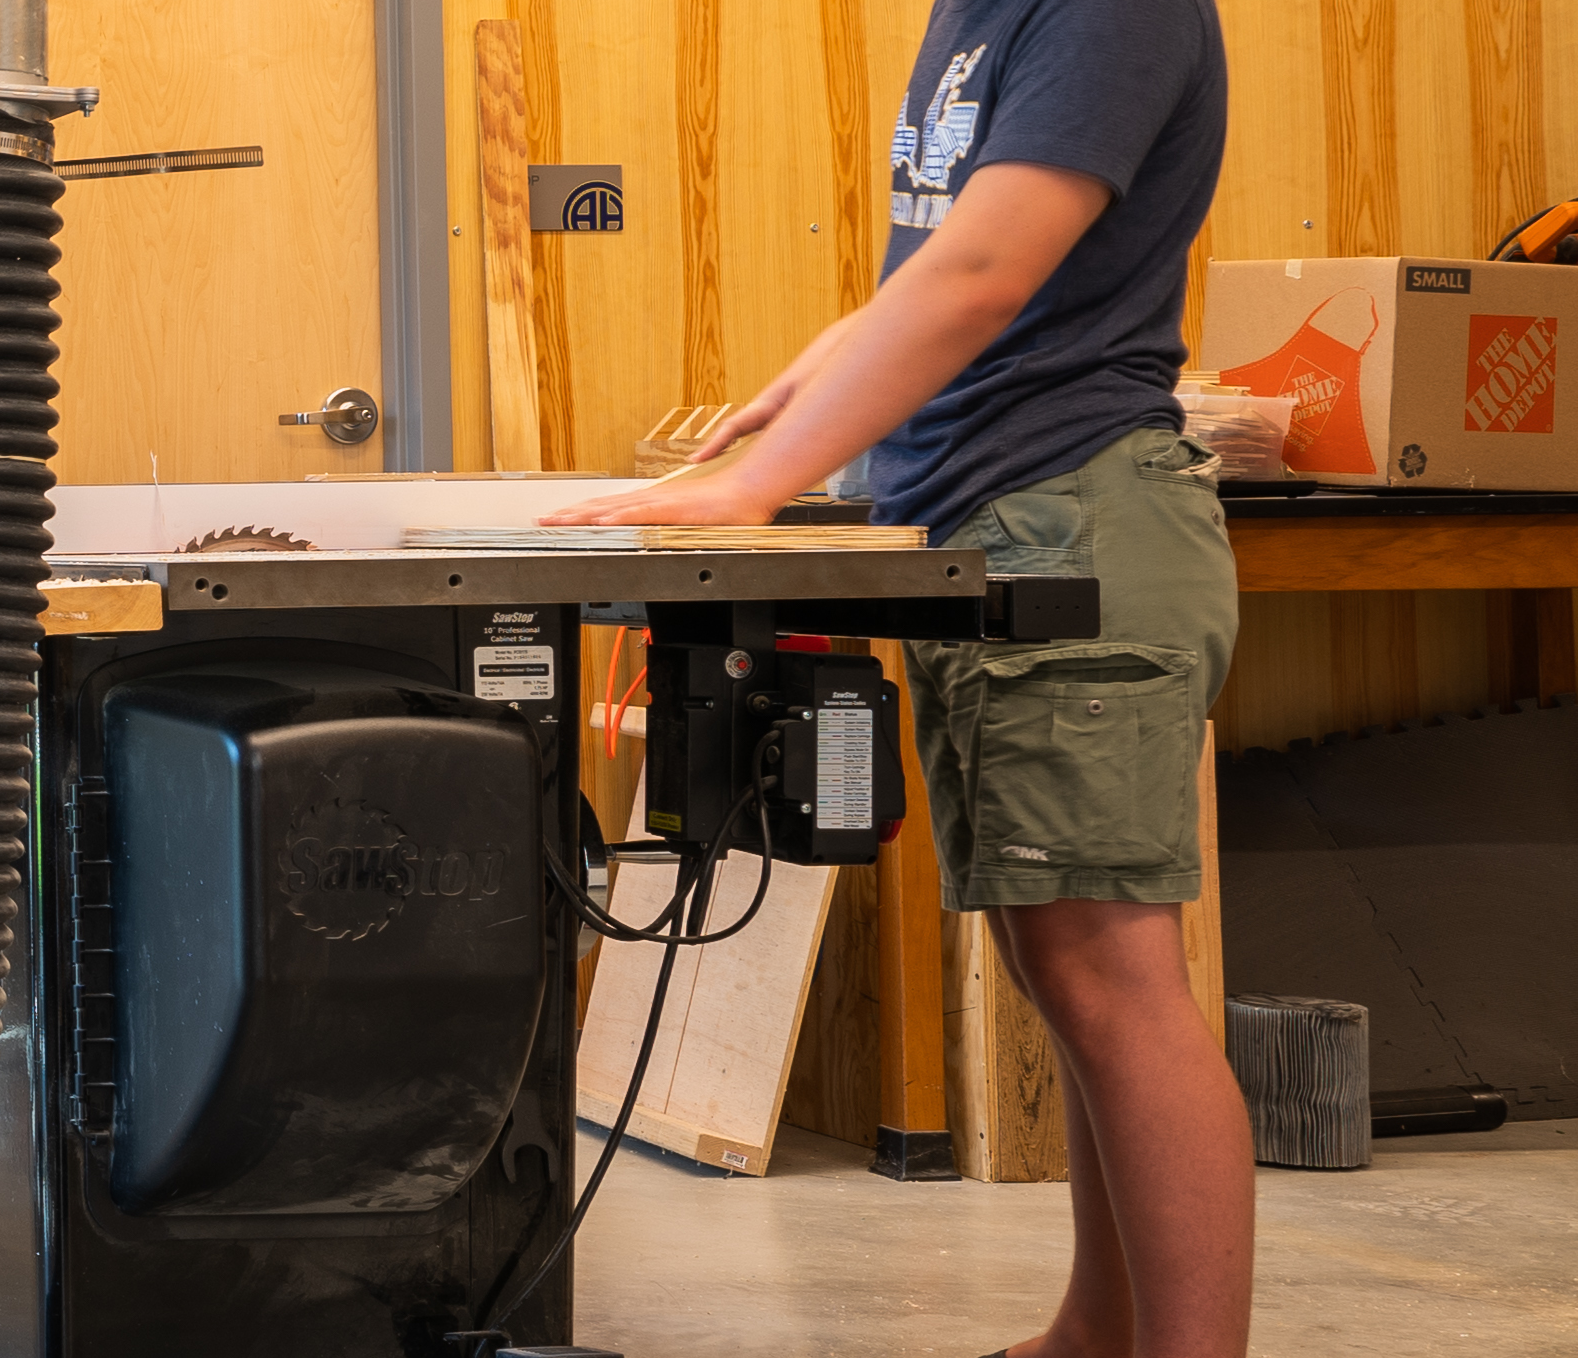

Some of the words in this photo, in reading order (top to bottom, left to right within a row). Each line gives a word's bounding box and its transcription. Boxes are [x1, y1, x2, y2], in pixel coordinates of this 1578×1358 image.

[1412, 271, 1464, 289] SMALL
[1476, 327, 1515, 373] THE
[1291, 372, 1317, 388] THE
[1466, 317, 1557, 432] HOME
[1499, 360, 1556, 432] DEPOT
